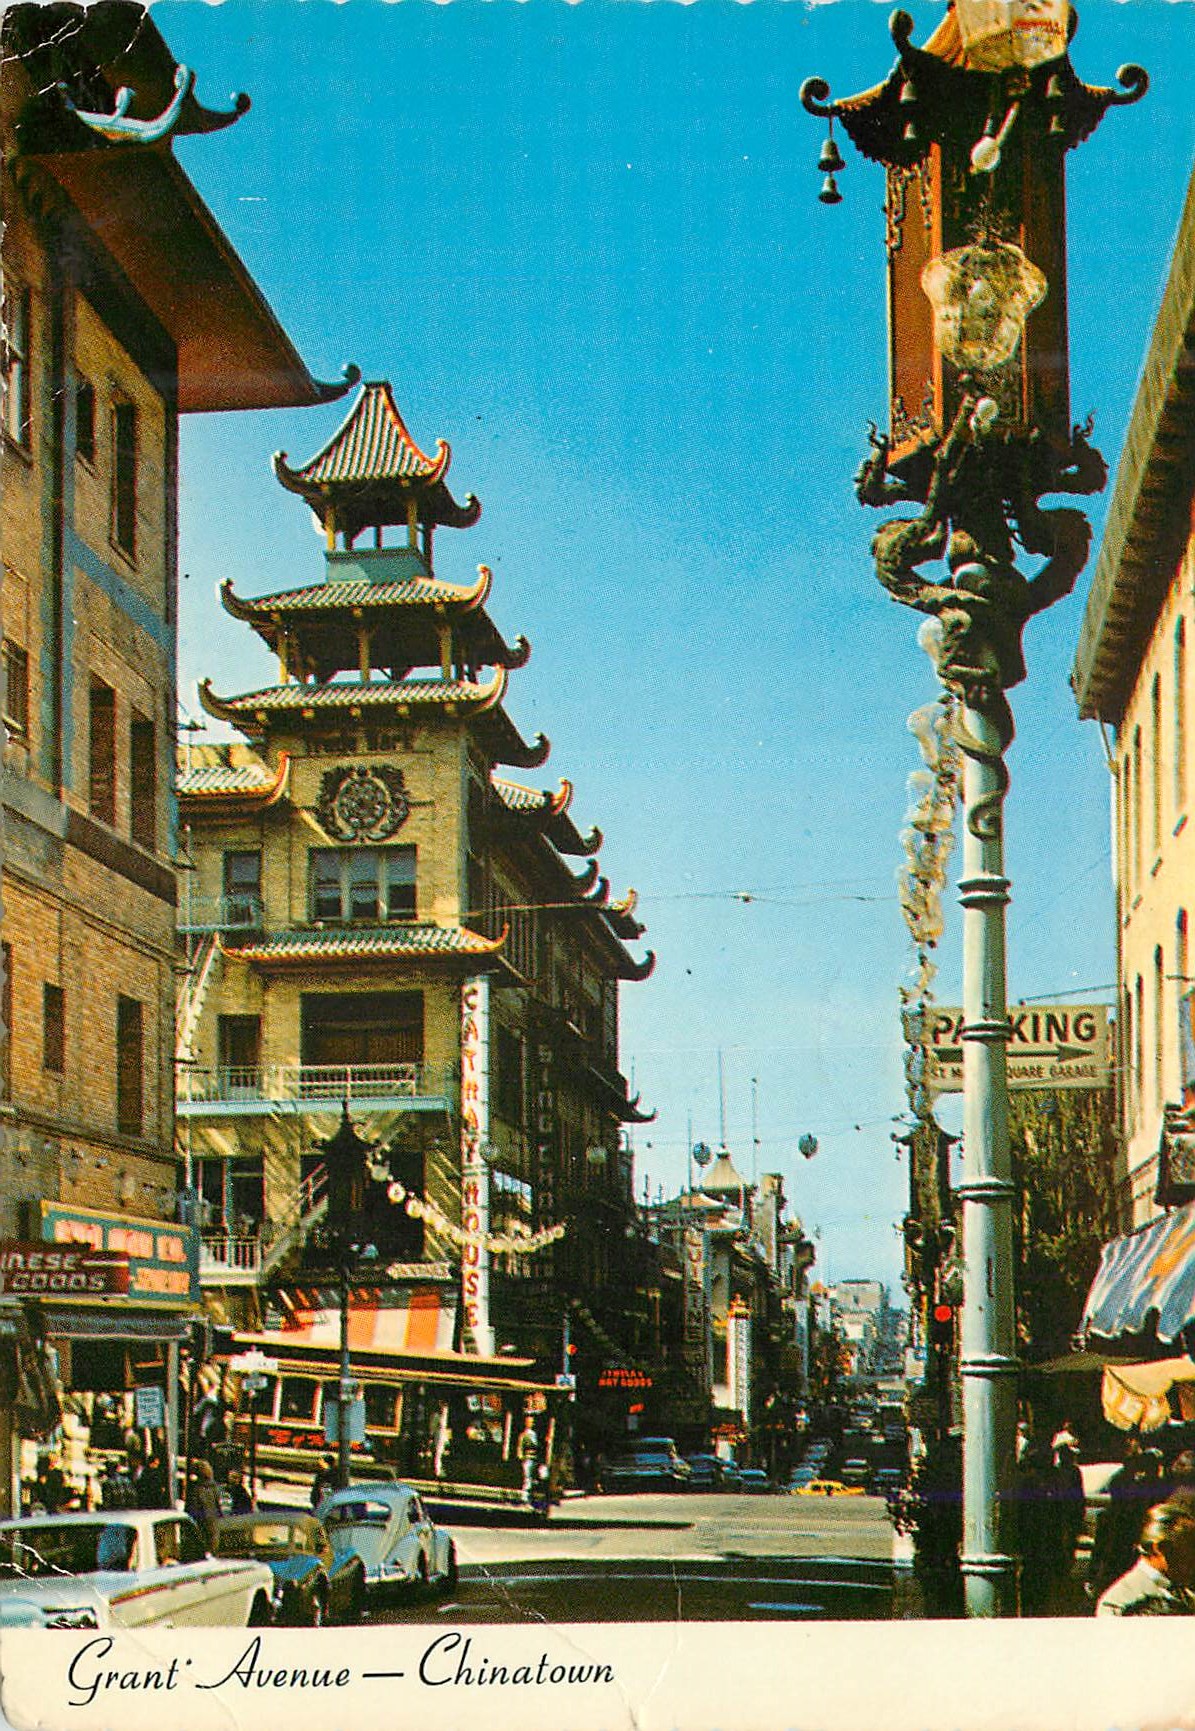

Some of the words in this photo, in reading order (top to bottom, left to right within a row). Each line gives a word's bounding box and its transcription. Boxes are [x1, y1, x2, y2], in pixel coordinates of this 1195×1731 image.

[463, 986, 479, 1163] CATHAY
[933, 1013, 1096, 1044] PAKING
[463, 1181, 479, 1327] HOUSE
